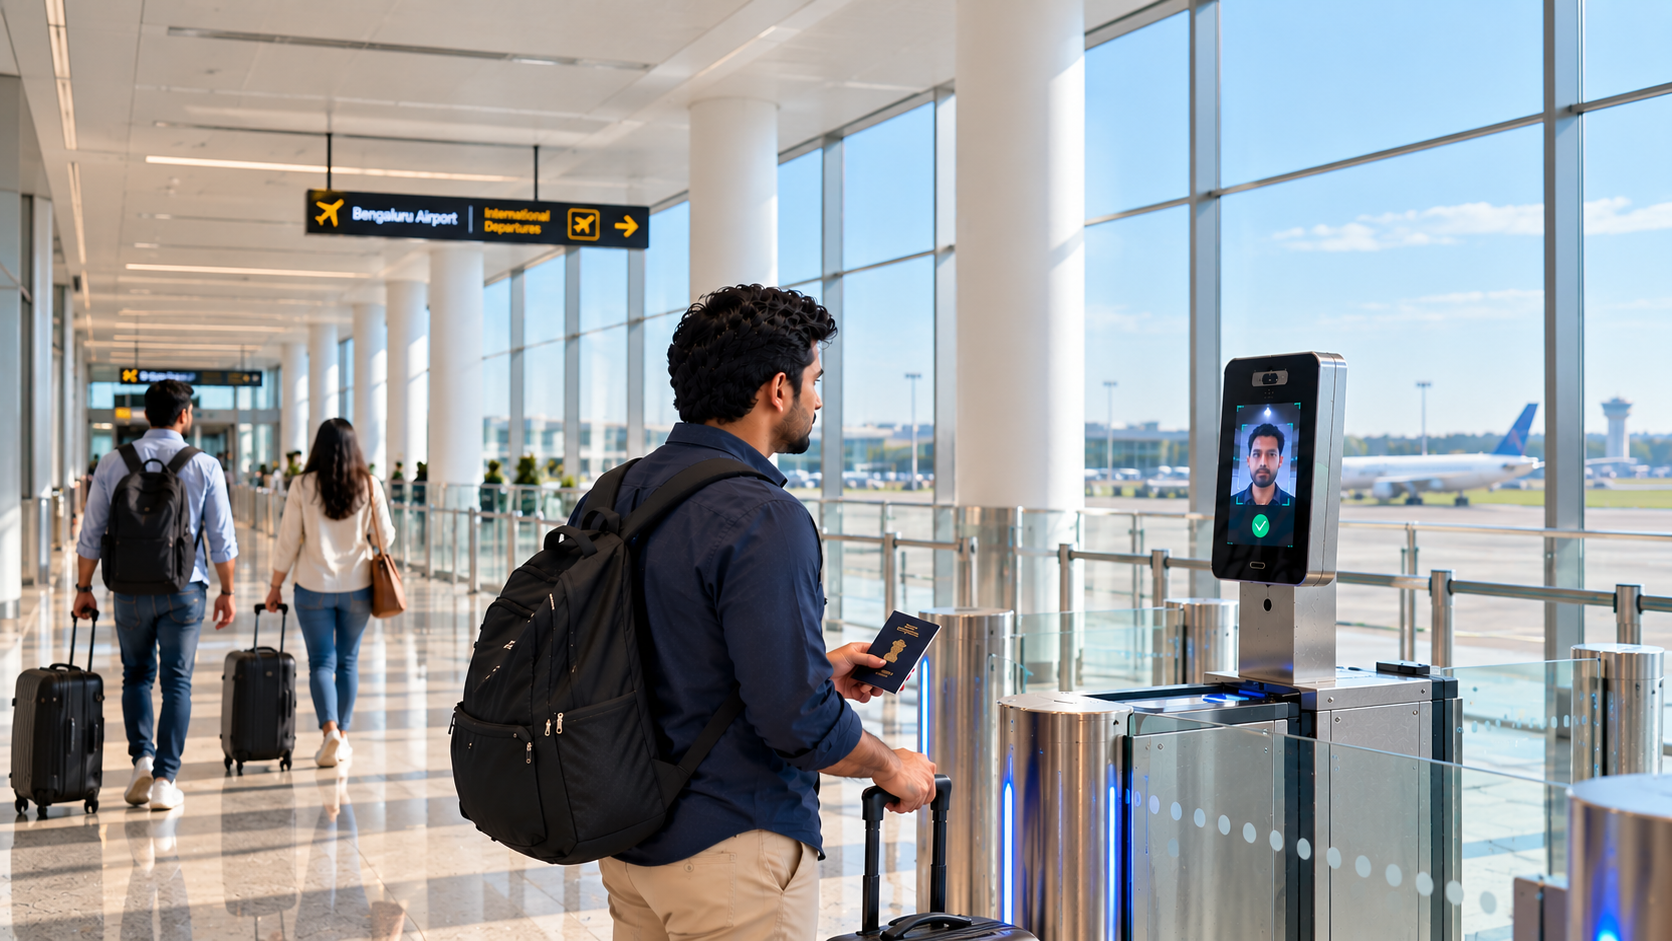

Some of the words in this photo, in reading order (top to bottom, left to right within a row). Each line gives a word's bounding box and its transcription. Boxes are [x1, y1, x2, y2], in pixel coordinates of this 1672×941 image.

[352, 206, 414, 225] Bengaluru
[415, 209, 459, 227] Airport
[484, 207, 551, 222] International
[484, 220, 542, 235] Departures
